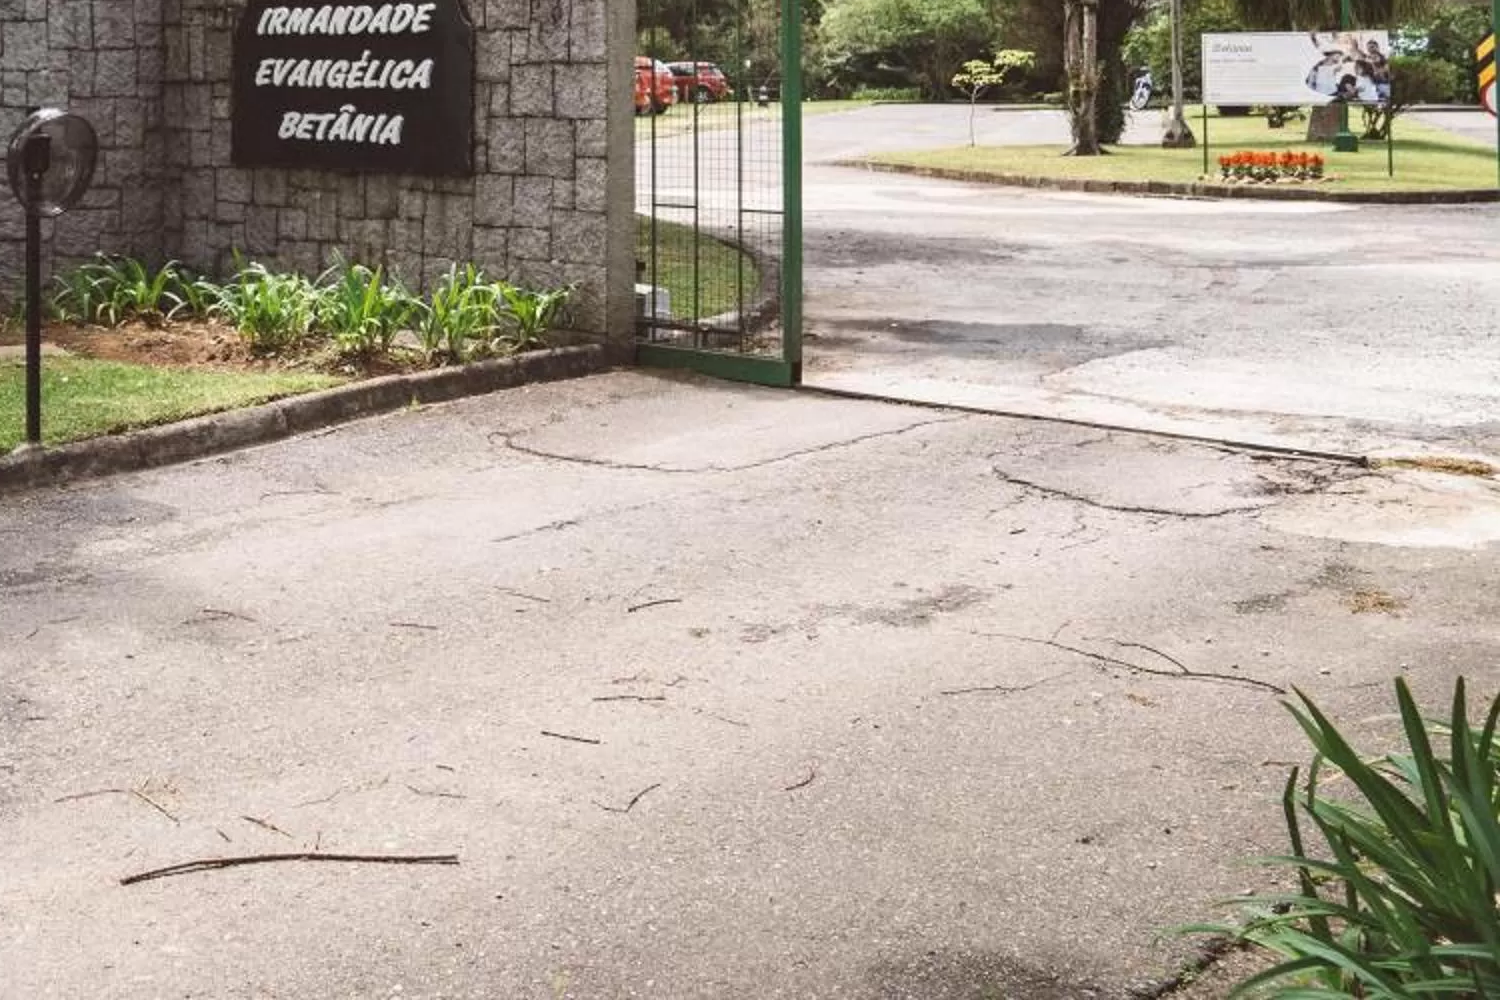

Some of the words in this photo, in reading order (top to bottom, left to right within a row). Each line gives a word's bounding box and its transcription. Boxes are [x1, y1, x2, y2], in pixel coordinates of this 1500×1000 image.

[257, 3, 436, 35] IRMANDADE
[255, 50, 434, 89] EVANGÉLICA
[278, 104, 404, 145] BETÂNIA
